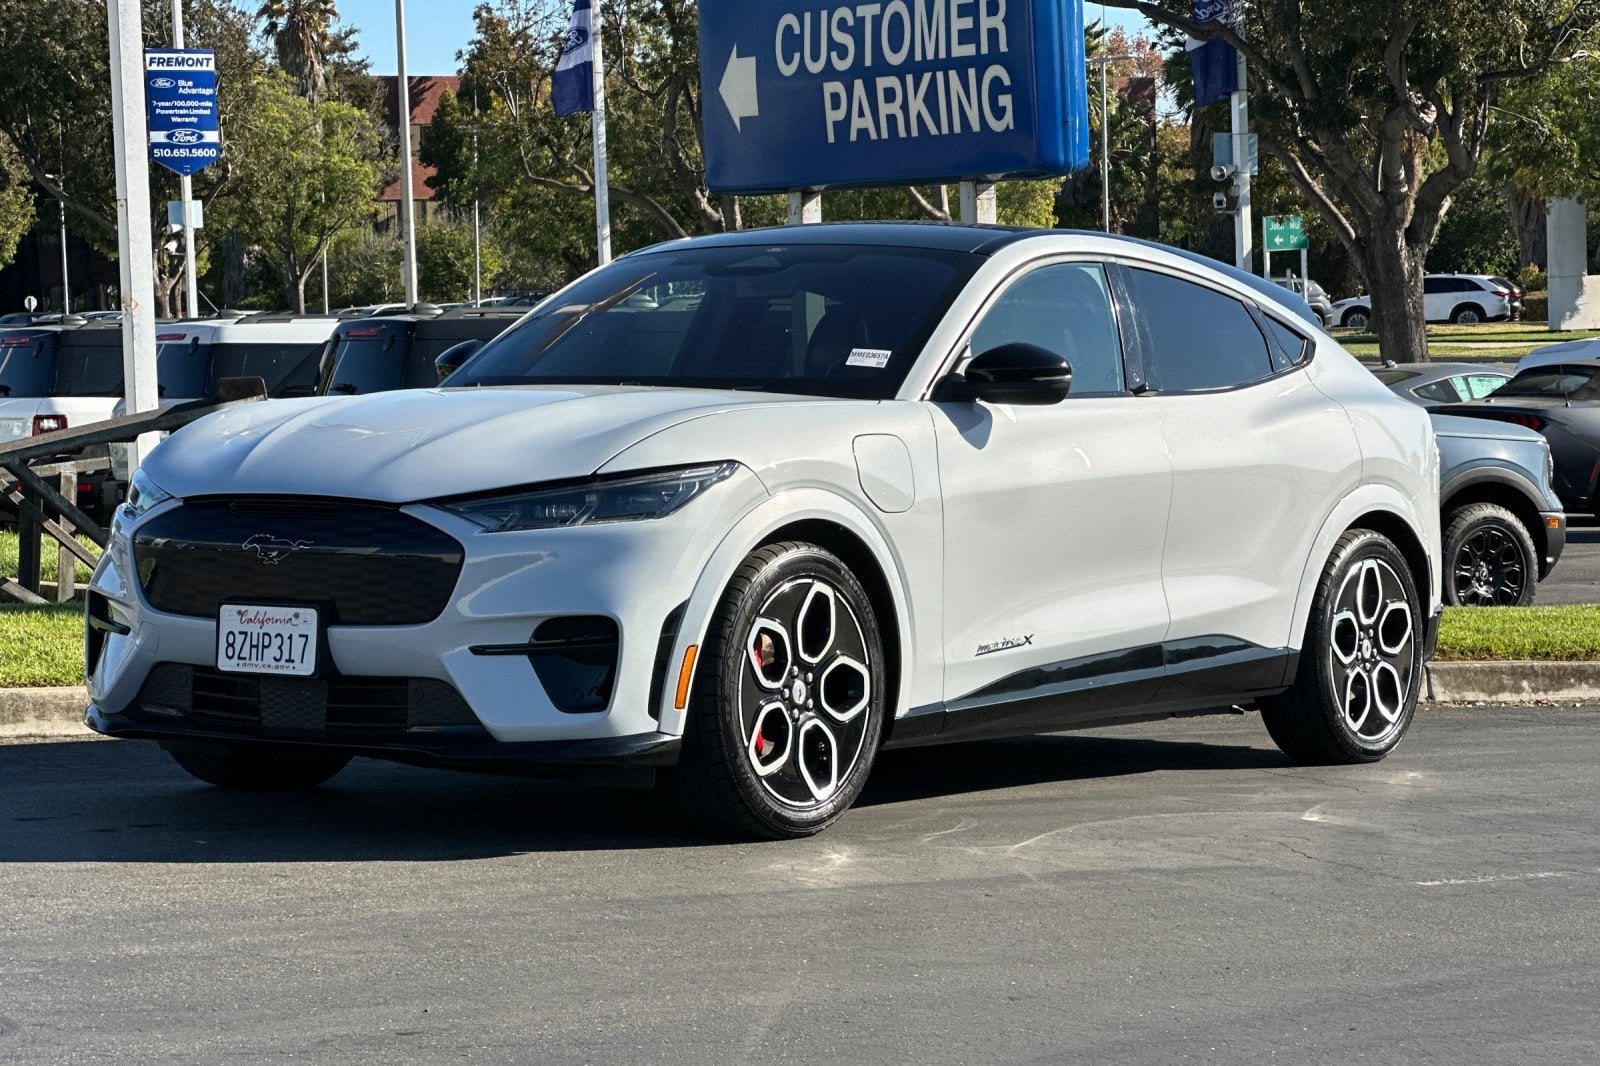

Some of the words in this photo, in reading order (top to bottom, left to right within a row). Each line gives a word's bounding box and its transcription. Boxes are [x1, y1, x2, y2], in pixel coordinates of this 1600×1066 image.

[775, 0, 1009, 76] CUSTOMER
[149, 56, 212, 67] FREMONT
[177, 79, 194, 87] Blue
[178, 87, 214, 95] Advantage
[822, 64, 1014, 144] PARKING
[153, 148, 217, 158] 510.651.5600
[1290, 235, 1299, 244] Dr
[239, 609, 299, 630] California
[225, 630, 309, 664] 8ZHP317
